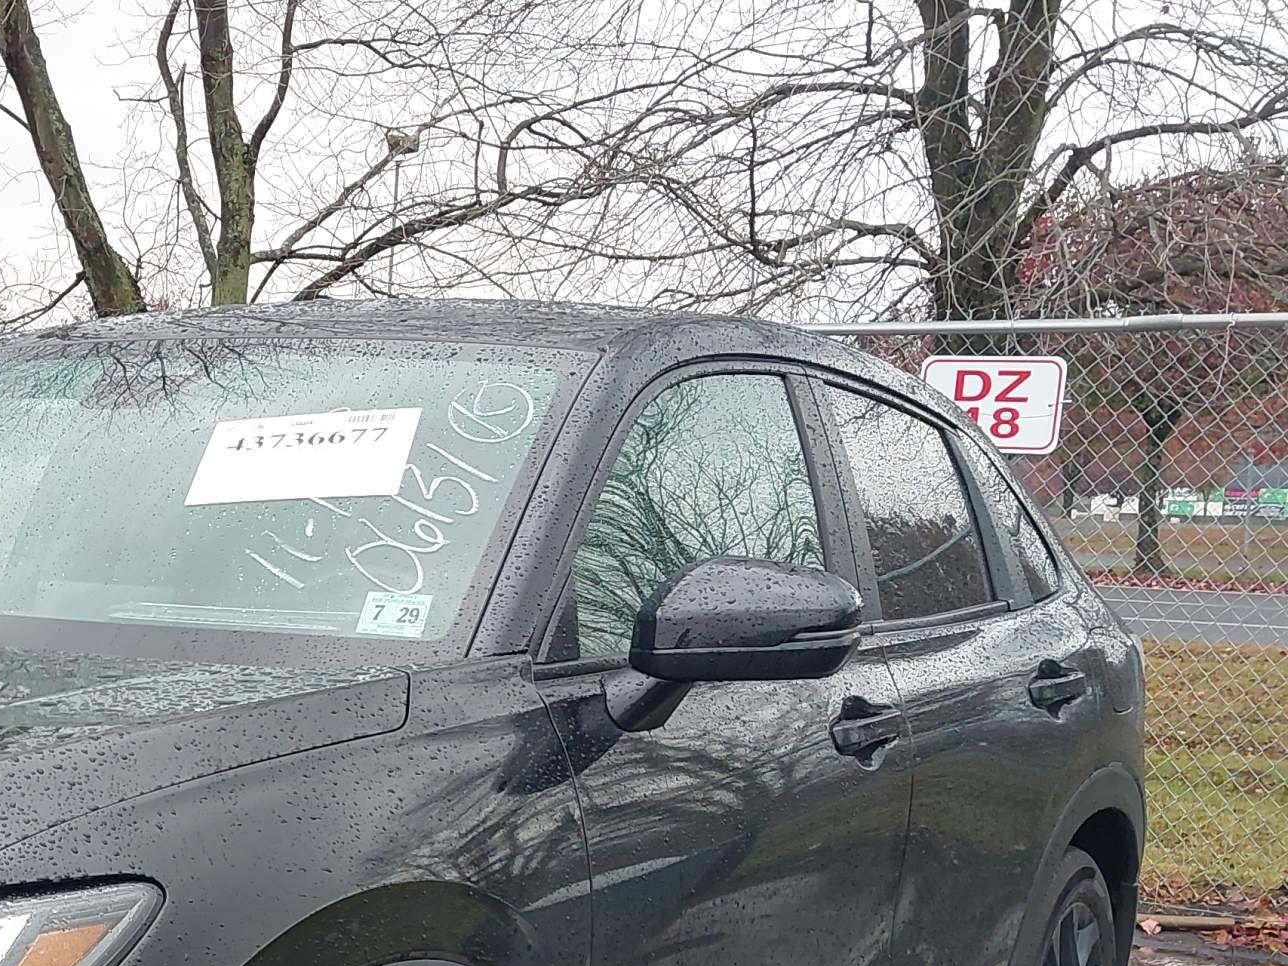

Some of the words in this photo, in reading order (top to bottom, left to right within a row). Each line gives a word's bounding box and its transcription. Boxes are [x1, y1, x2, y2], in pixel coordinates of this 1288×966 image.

[954, 370, 1031, 402] DZ
[226, 427, 389, 451] 43736677
[372, 604, 386, 621] 7
[395, 606, 420, 624] 29
